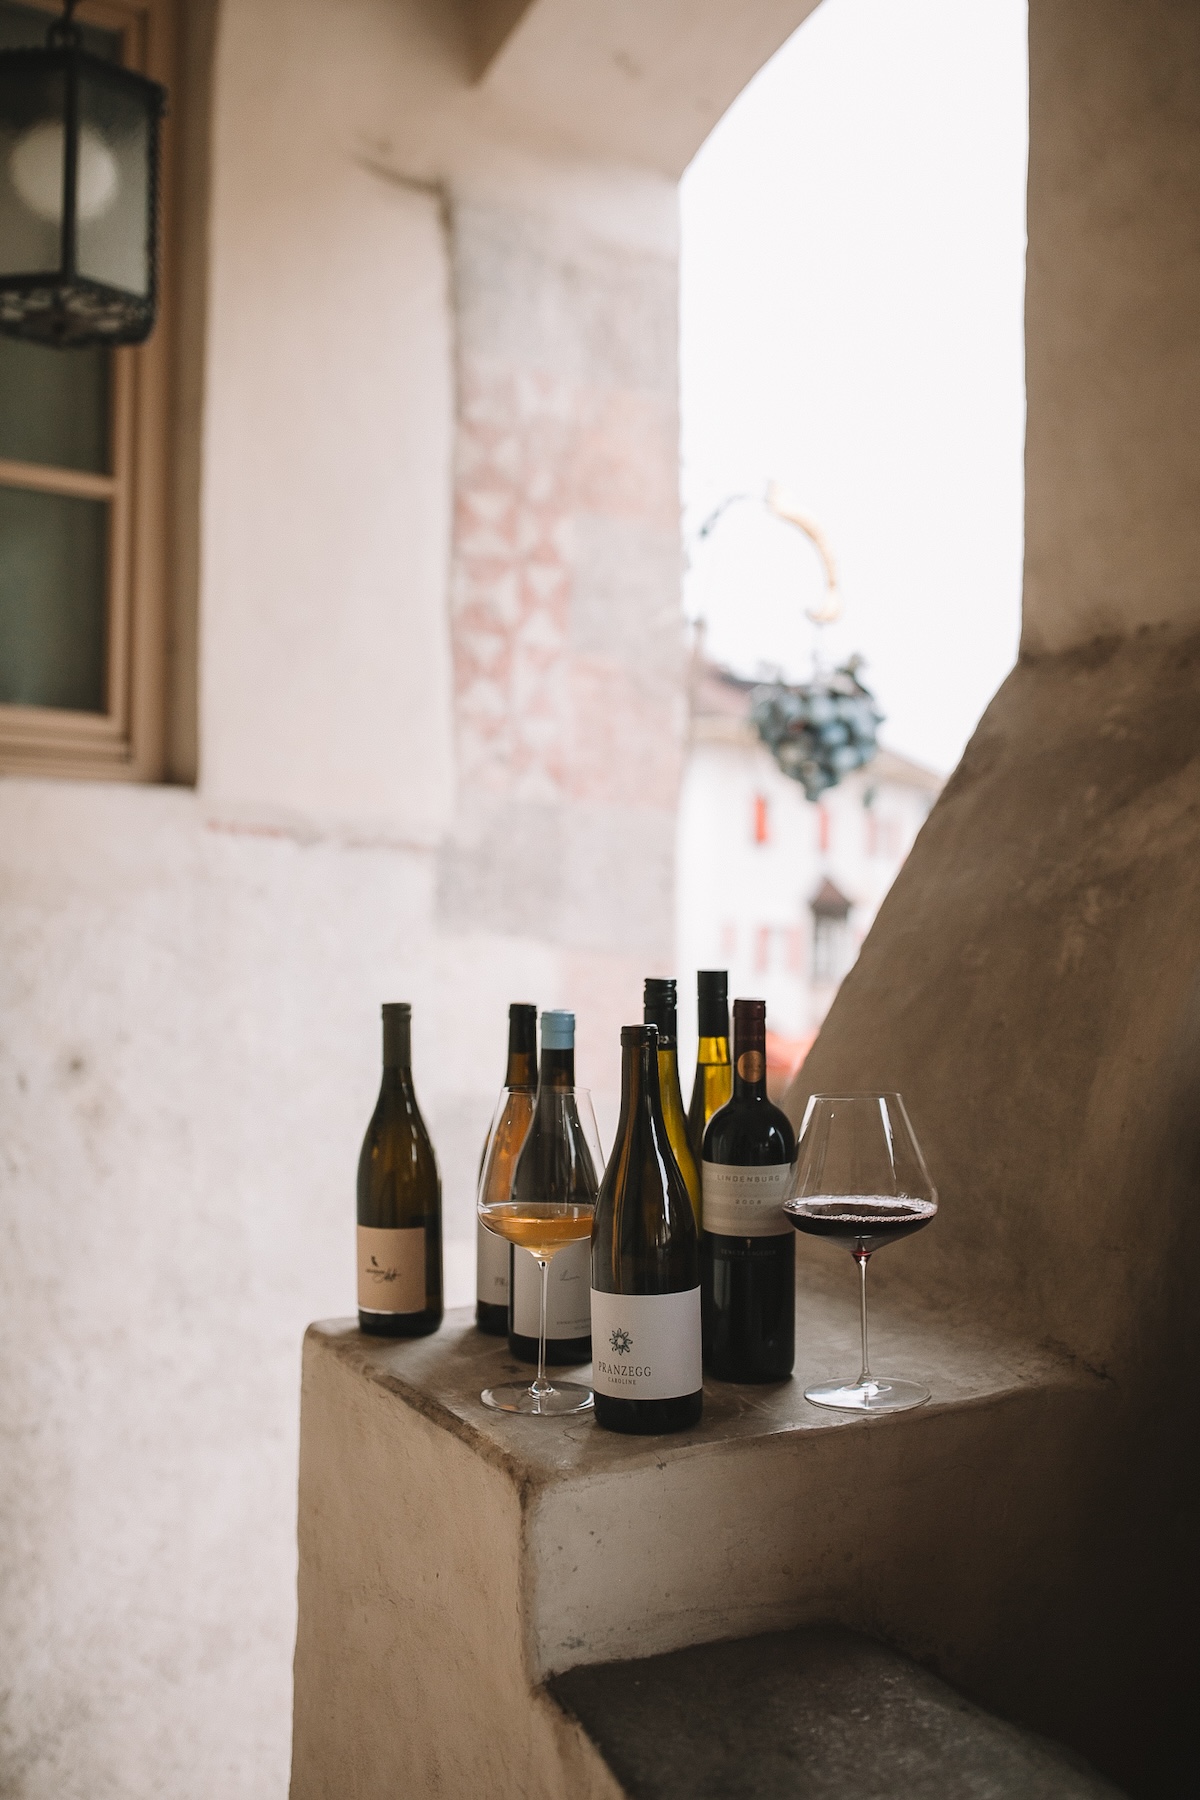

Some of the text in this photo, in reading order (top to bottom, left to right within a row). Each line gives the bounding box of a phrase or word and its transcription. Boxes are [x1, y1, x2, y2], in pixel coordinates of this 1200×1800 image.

[717, 1175, 780, 1183] LINDENBURG
[598, 1361, 652, 1377] PRANZEGG
[608, 1376, 637, 1385] CAROLINE
